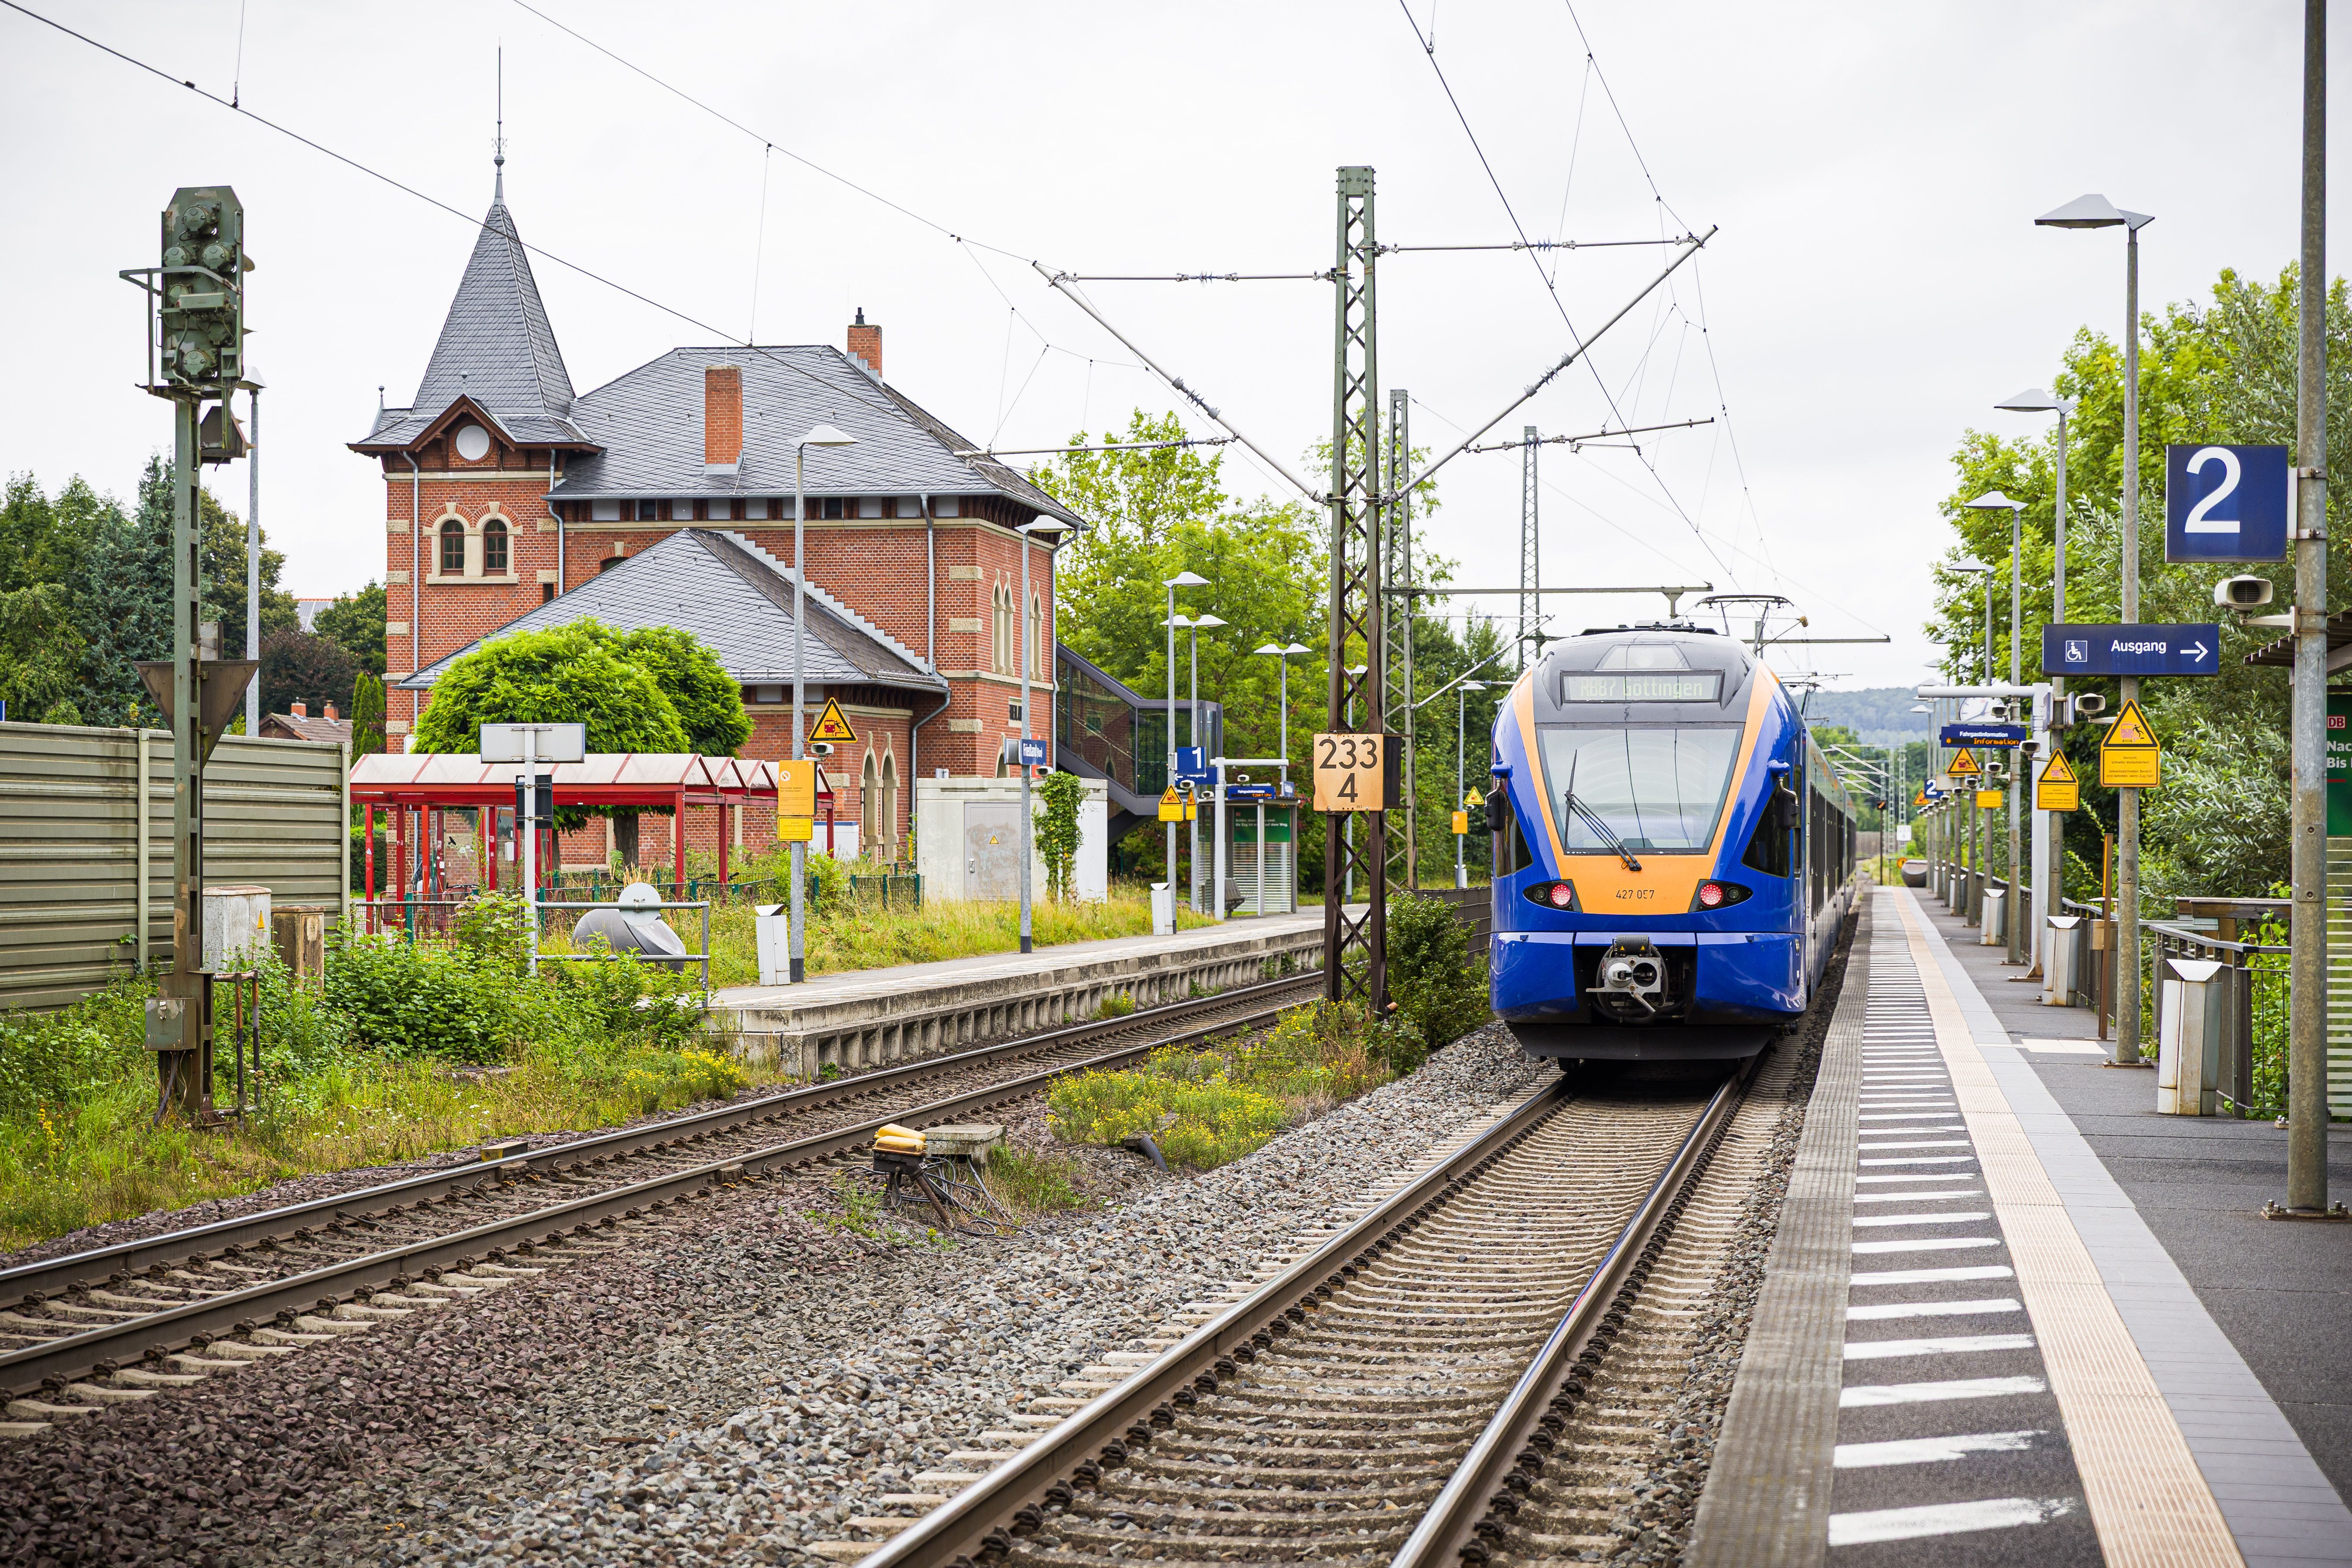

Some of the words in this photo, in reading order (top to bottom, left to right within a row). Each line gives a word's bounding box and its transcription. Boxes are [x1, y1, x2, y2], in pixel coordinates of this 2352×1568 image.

[2184, 447, 2241, 533] 2
[2111, 639, 2167, 654] Ausgang
[1580, 677, 1616, 697] RB87
[1622, 676, 1702, 698] Göttingen
[2328, 717, 2345, 728] DB
[1192, 747, 1201, 769] 1
[1319, 738, 1378, 769] 233
[2327, 756, 2347, 768] Bis
[1337, 773, 1358, 803] 4
[1926, 779, 1937, 795] 2
[1616, 890, 1633, 899] 427
[1637, 890, 1655, 899] 057
